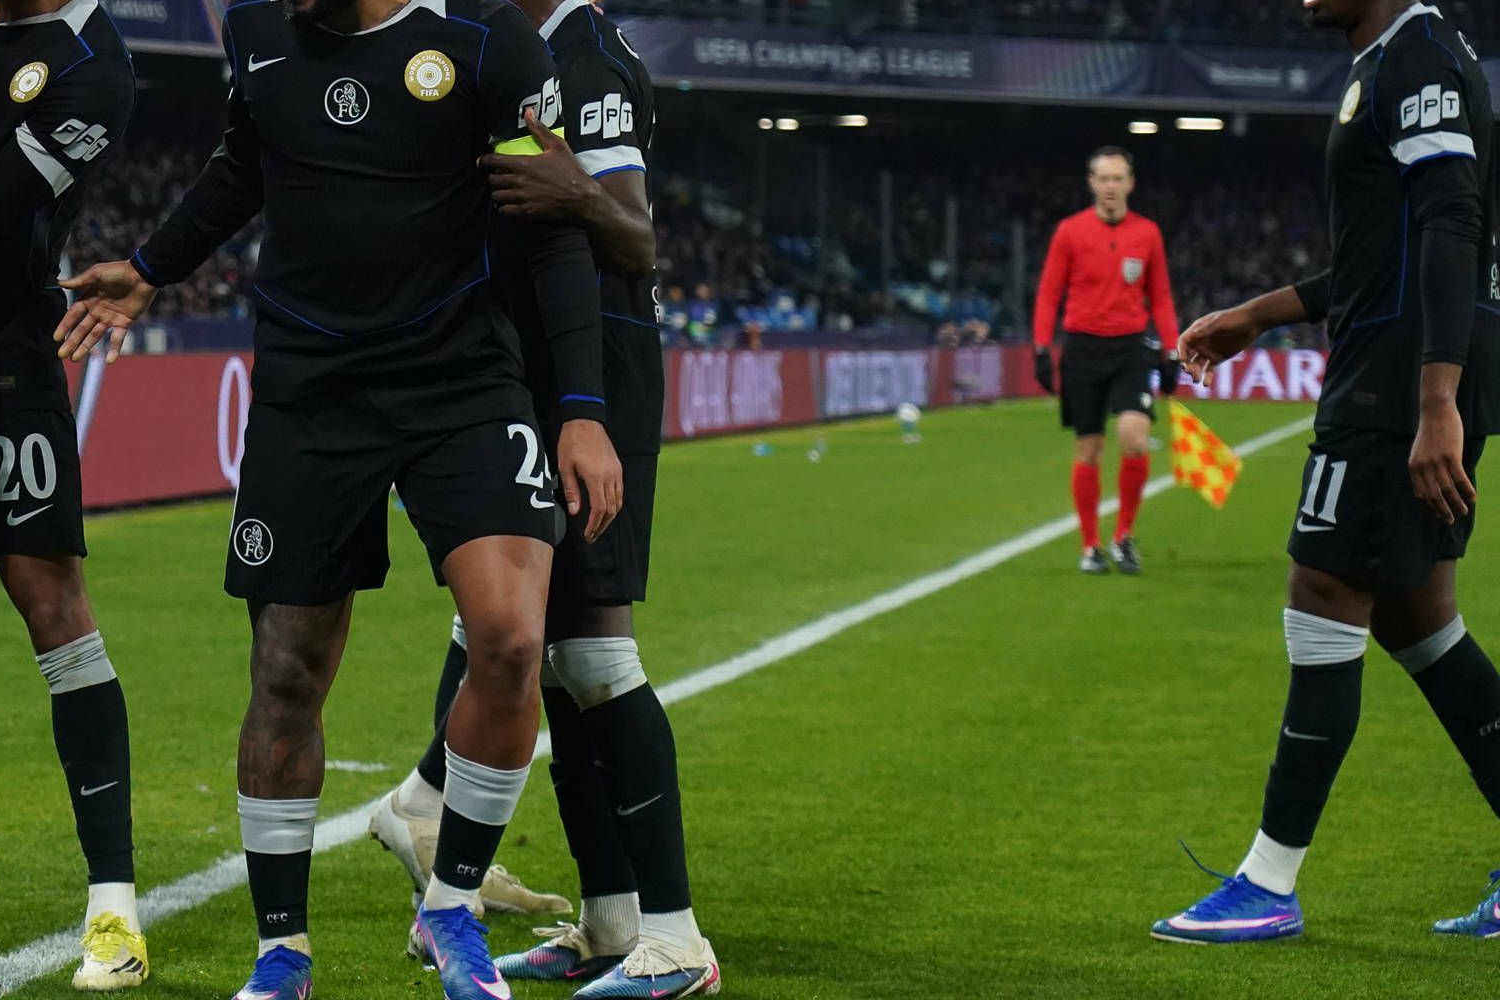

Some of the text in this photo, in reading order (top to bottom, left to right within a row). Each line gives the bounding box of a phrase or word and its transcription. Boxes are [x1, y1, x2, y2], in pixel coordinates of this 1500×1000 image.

[694, 38, 749, 65] UEFA
[886, 48, 969, 78] LEAGUE
[420, 88, 439, 97] FIFA
[1402, 92, 1458, 126] FPT
[582, 101, 633, 133] FPT
[507, 424, 552, 489] 2
[1301, 453, 1348, 525] 11
[457, 863, 479, 877] CFC
[266, 912, 288, 924] CFC
